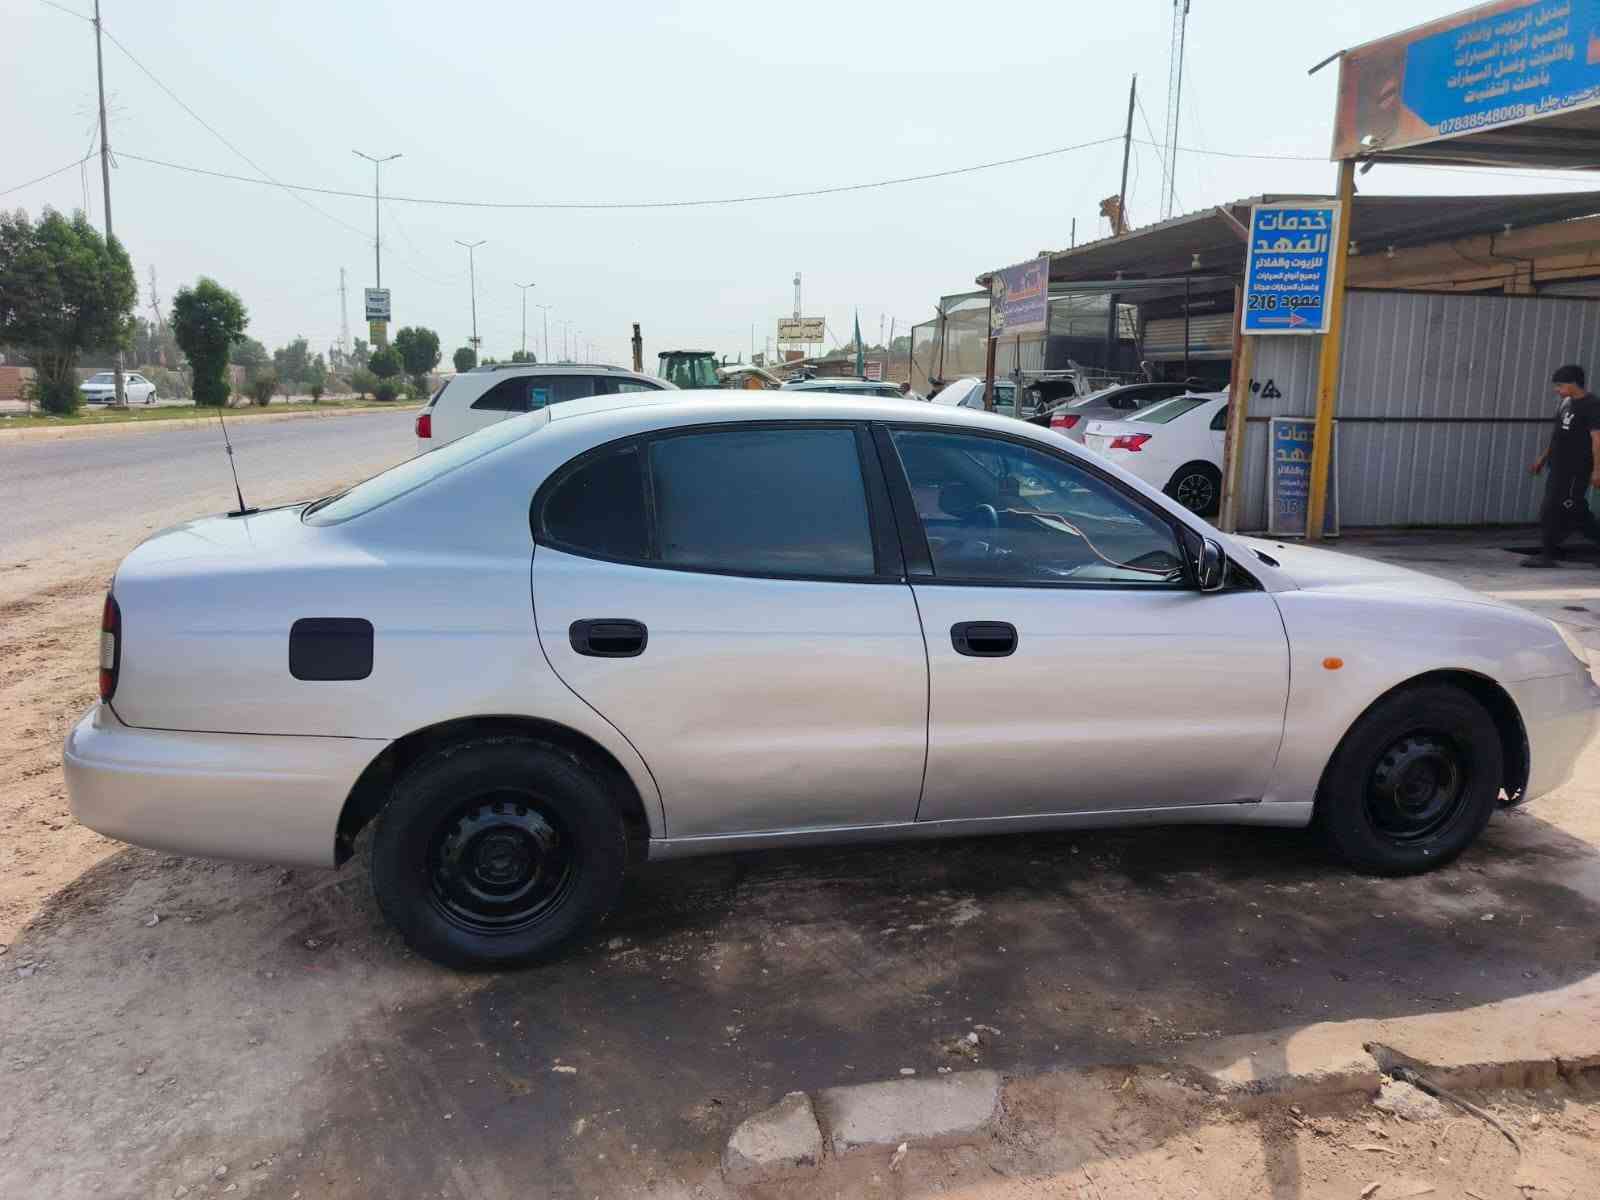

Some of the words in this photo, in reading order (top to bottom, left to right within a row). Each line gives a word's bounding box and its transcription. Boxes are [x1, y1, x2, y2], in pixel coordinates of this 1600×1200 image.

[1440, 104, 1524, 134] 07838548008
[1258, 211, 1327, 230] خدمات
[1253, 233, 1328, 254] الفهد
[1291, 257, 1323, 270] للزيوت
[1247, 294, 1279, 311] 216
[1280, 295, 1320, 311] عمود
